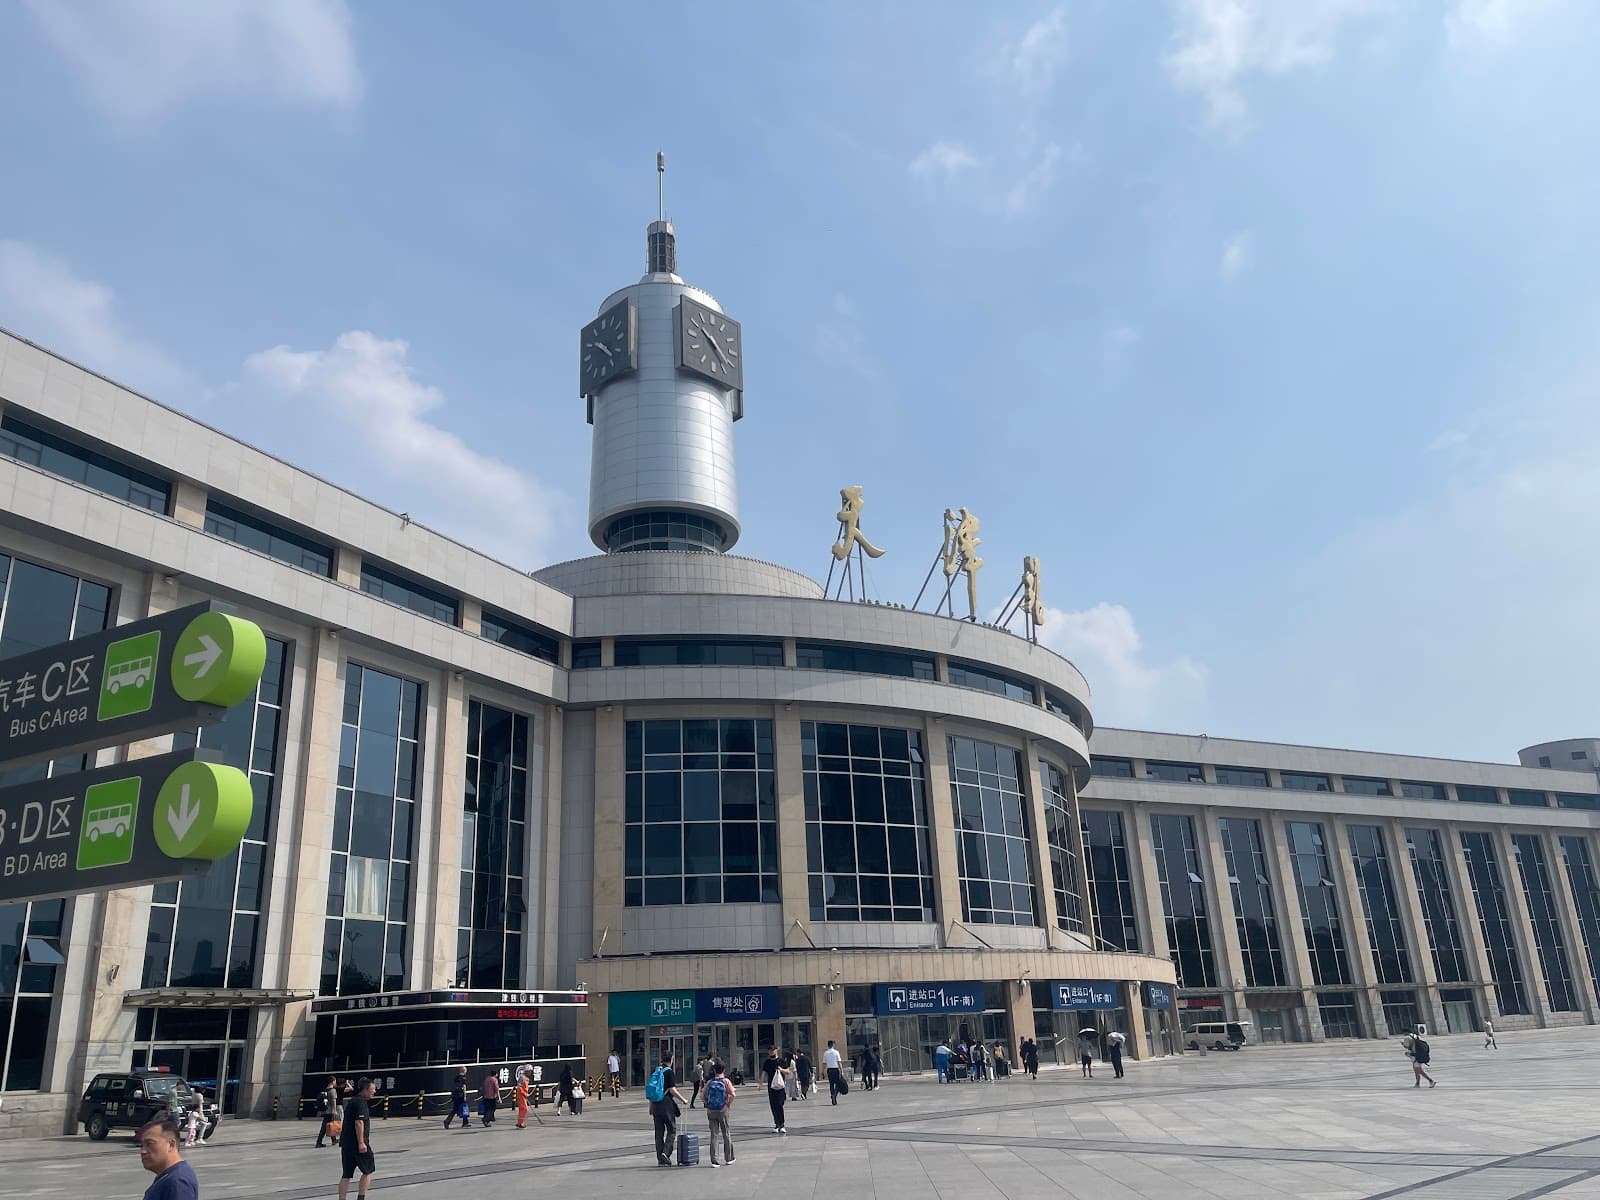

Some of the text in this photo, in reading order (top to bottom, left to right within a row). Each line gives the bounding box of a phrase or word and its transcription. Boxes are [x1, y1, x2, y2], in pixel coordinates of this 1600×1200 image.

[10, 719, 37, 738] Bus
[51, 706, 88, 728] Area
[0, 796, 75, 845] ·D区
[33, 851, 67, 872] Area
[909, 989, 936, 1001] 进站口
[670, 998, 692, 1010] 出口
[712, 996, 744, 1009] 售票处
[909, 1001, 934, 1009] Entrance
